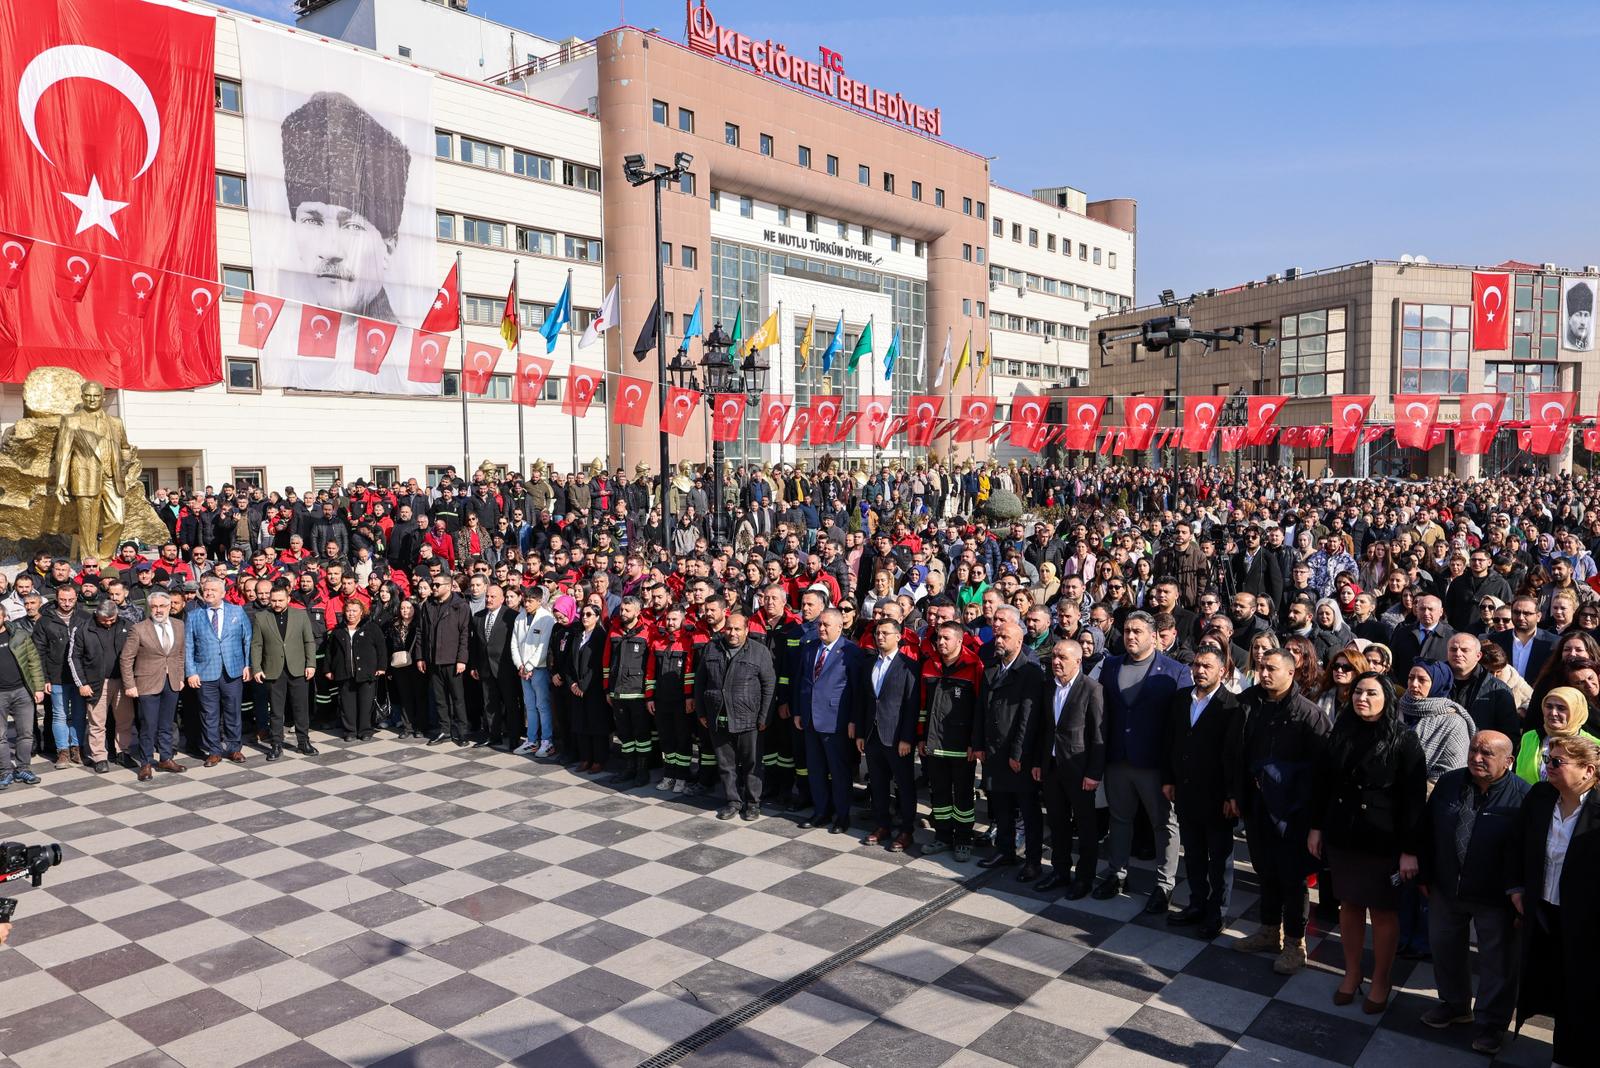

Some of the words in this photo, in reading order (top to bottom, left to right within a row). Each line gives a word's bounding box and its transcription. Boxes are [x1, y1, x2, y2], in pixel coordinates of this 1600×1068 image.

[716, 26, 834, 96] KEÇİÖREN
[837, 75, 941, 136] BELEDİYESİ
[763, 229, 776, 242] NE
[778, 232, 808, 249] MUTLU
